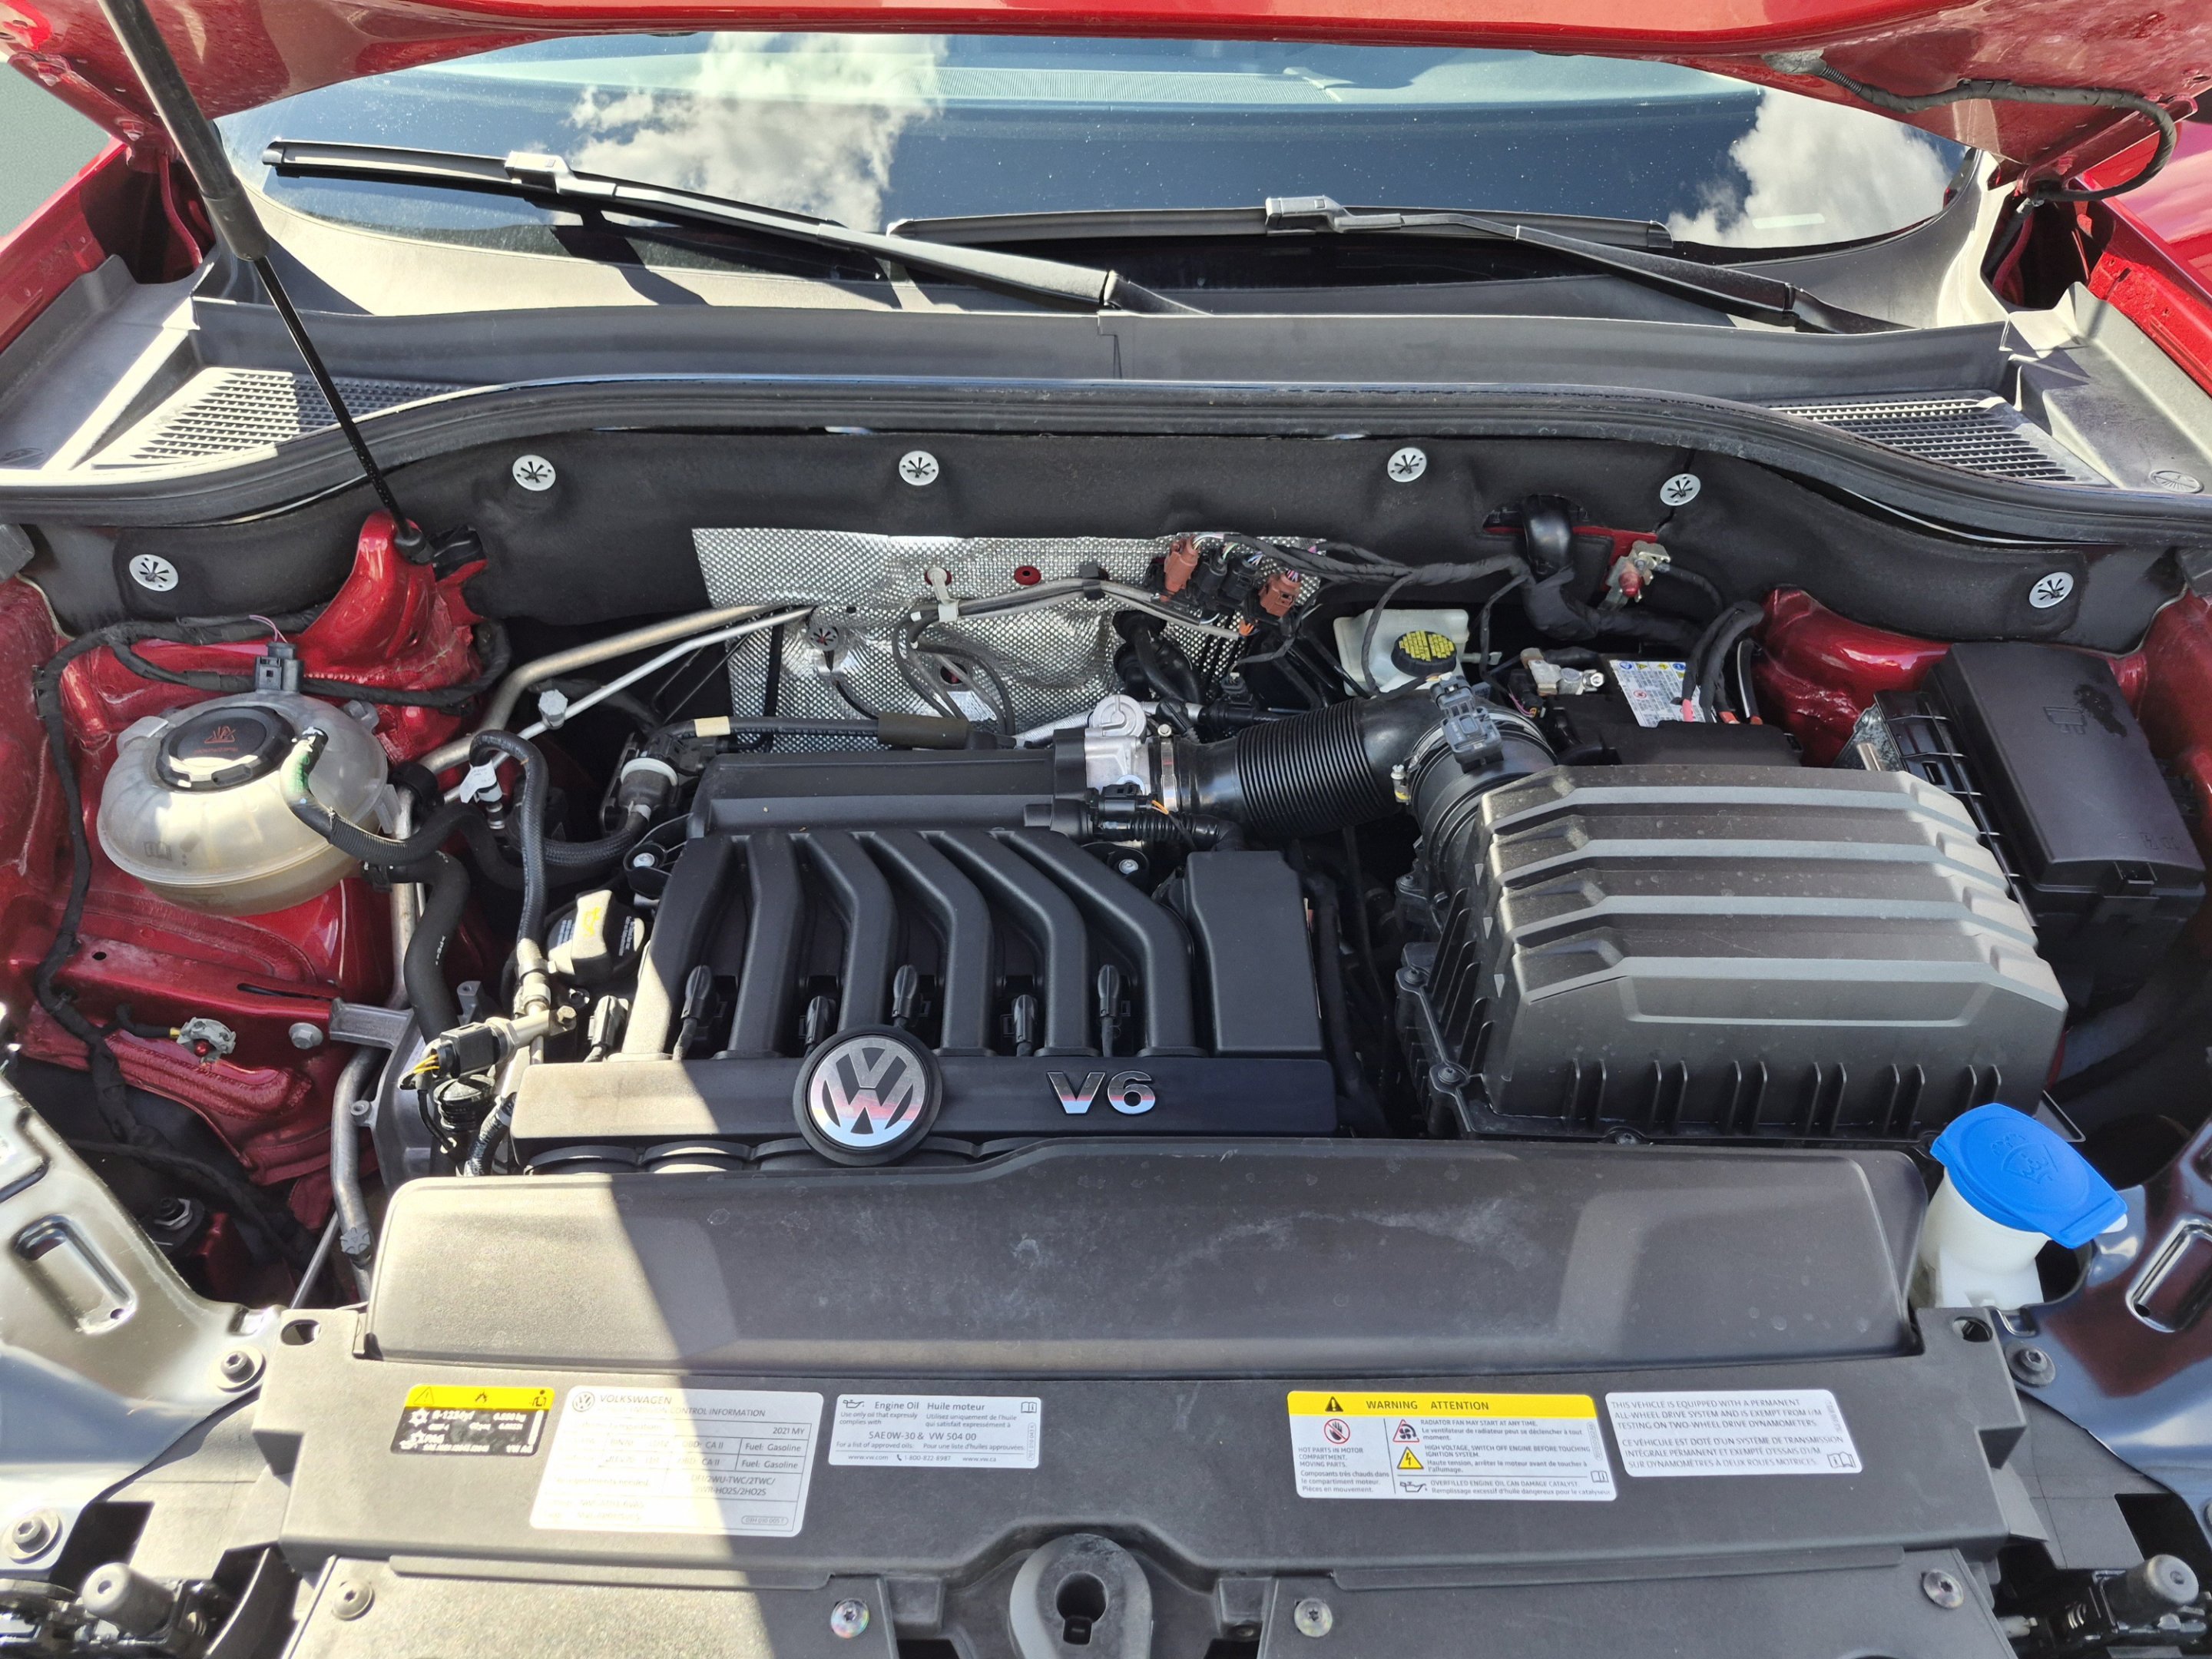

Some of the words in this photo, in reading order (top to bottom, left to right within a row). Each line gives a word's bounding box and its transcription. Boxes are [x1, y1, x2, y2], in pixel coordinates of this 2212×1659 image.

[810, 1036, 926, 1147] VW
[1047, 1070, 1155, 1114] V6
[600, 1394, 673, 1405] VOLKSWAGEN
[1676, 1400, 1717, 1409] EQUIPPED
[875, 1401, 904, 1411] Engine
[1366, 1400, 1418, 1409] WARNING
[1430, 1401, 1489, 1410] ATTENTION
[670, 1406, 707, 1415] CONTROL
[709, 1407, 766, 1416] INFORMATION
[1720, 1409, 1739, 1418] AND
[869, 1431, 886, 1439] SAE
[965, 1432, 976, 1441] 00
[705, 1441, 717, 1449] CA
[745, 1442, 763, 1451] Fuel:
[767, 1443, 802, 1452] Gasoline
[1634, 1438, 1673, 1446] VÉHICULE
[741, 1459, 760, 1468] Fuel:
[763, 1460, 798, 1469] Gasoline
[1628, 1459, 1644, 1468] SUR
[1723, 1459, 1745, 1467] DEUX
